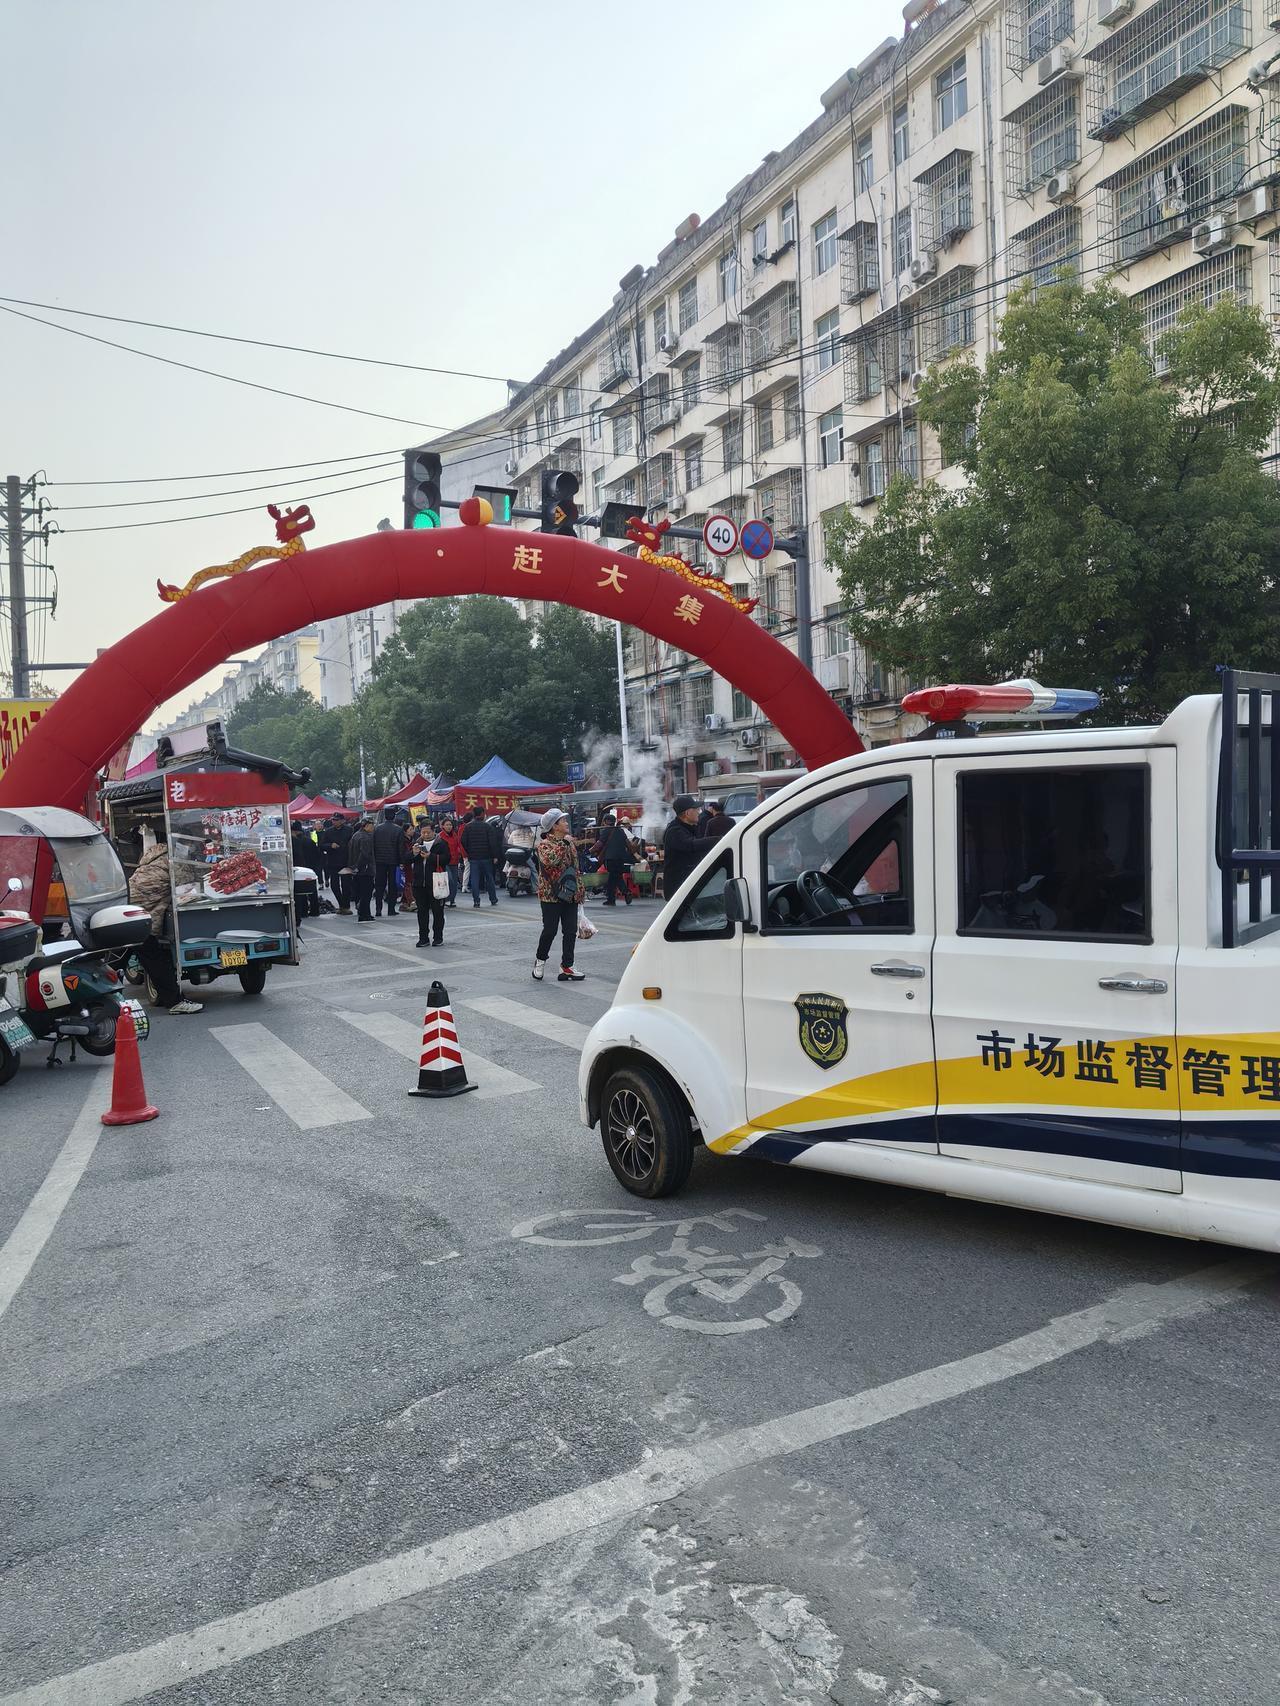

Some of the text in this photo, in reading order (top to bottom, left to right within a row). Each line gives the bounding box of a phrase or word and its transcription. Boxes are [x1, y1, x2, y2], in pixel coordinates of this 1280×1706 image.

[711, 526, 731, 545] 40
[512, 543, 705, 627] 赶大集
[976, 1029, 1280, 1102] 市场监督管理
